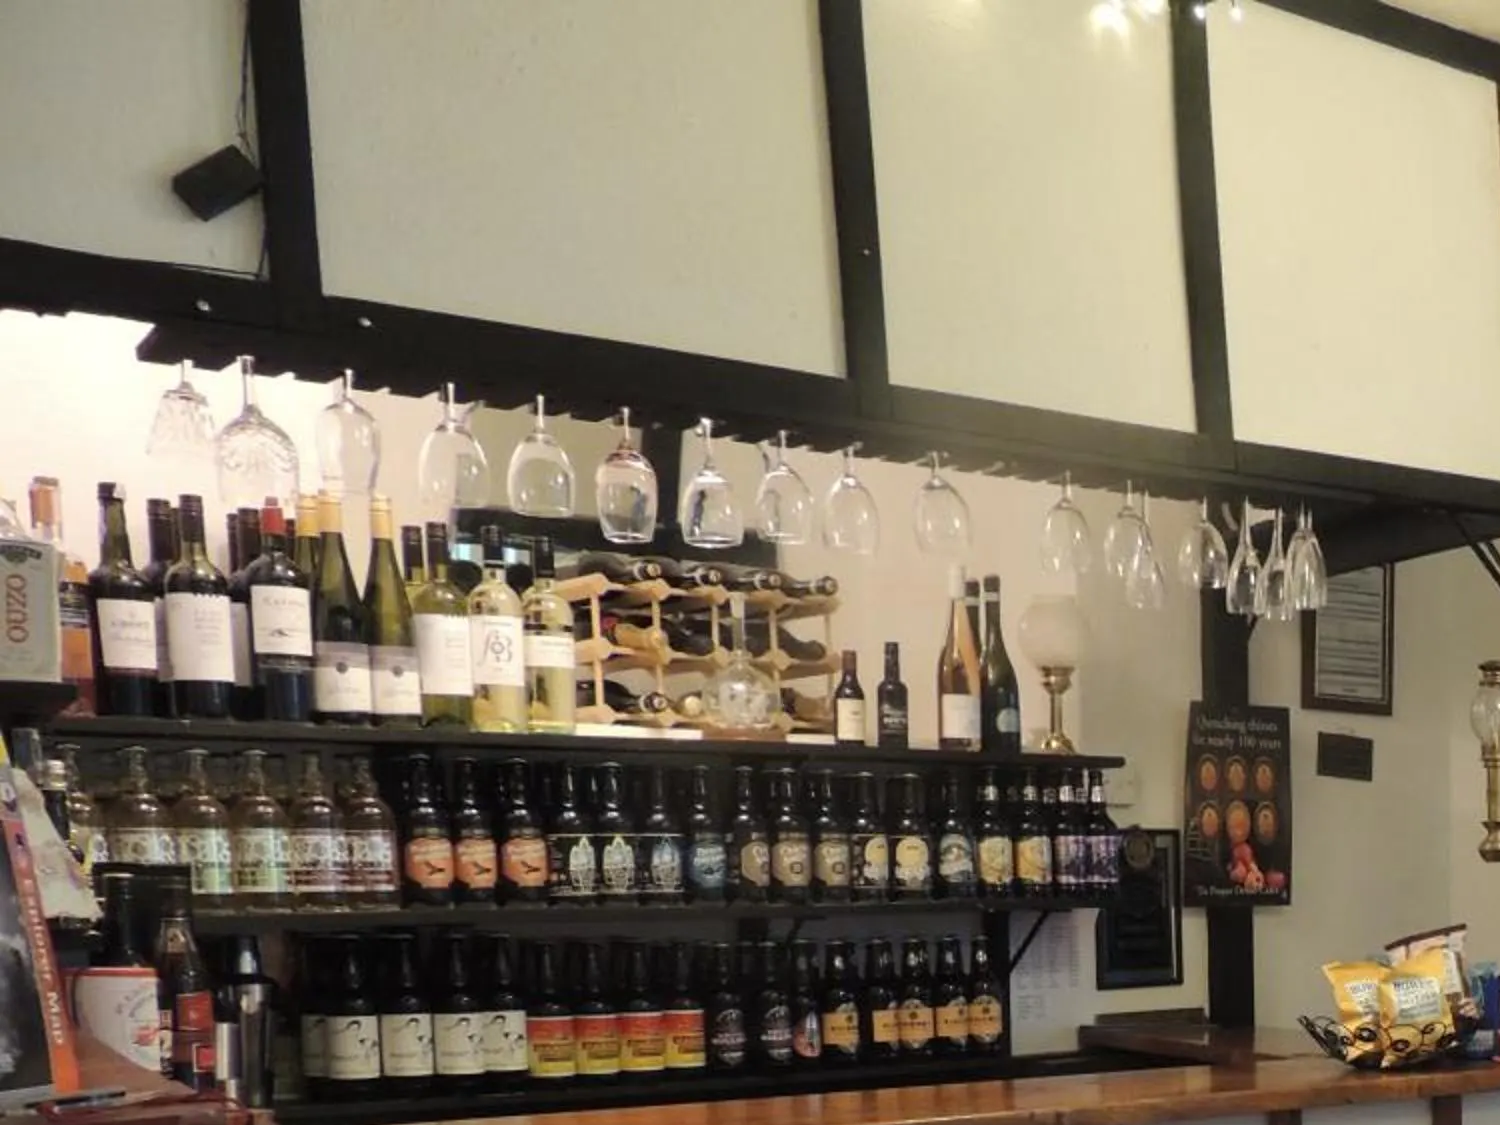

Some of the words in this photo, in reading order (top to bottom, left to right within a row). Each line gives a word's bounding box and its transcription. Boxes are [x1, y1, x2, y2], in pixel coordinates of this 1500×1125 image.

[5, 574, 29, 643] OUZO
[24, 878, 51, 983] Explorer
[47, 991, 64, 1046] Map
